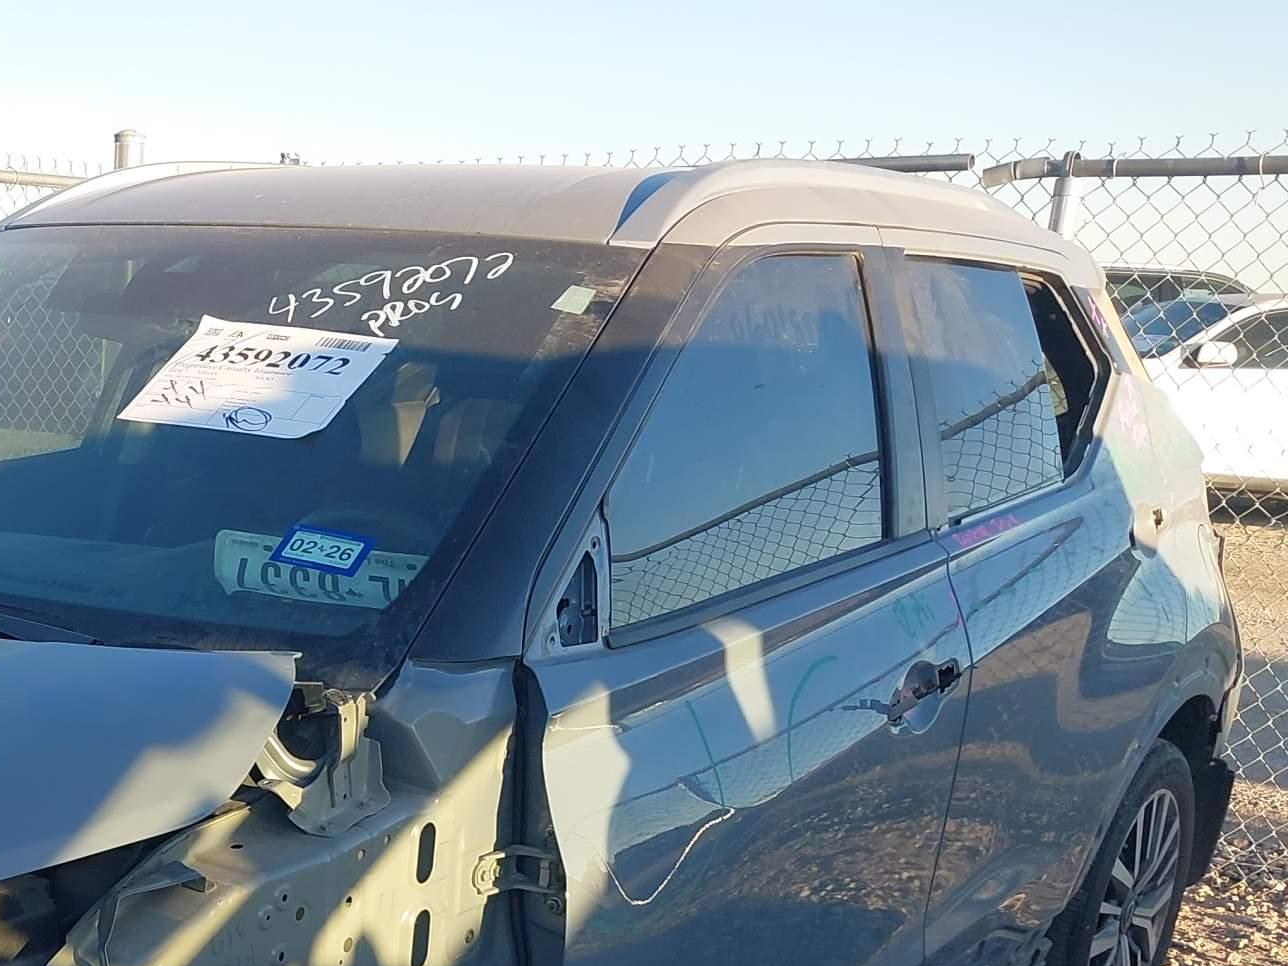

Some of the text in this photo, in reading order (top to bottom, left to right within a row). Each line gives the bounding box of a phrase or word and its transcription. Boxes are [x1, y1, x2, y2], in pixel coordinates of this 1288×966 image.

[268, 252, 514, 322] 43592072
[195, 344, 350, 376] 43592072
[289, 537, 318, 555] 02
[324, 544, 355, 562] 26
